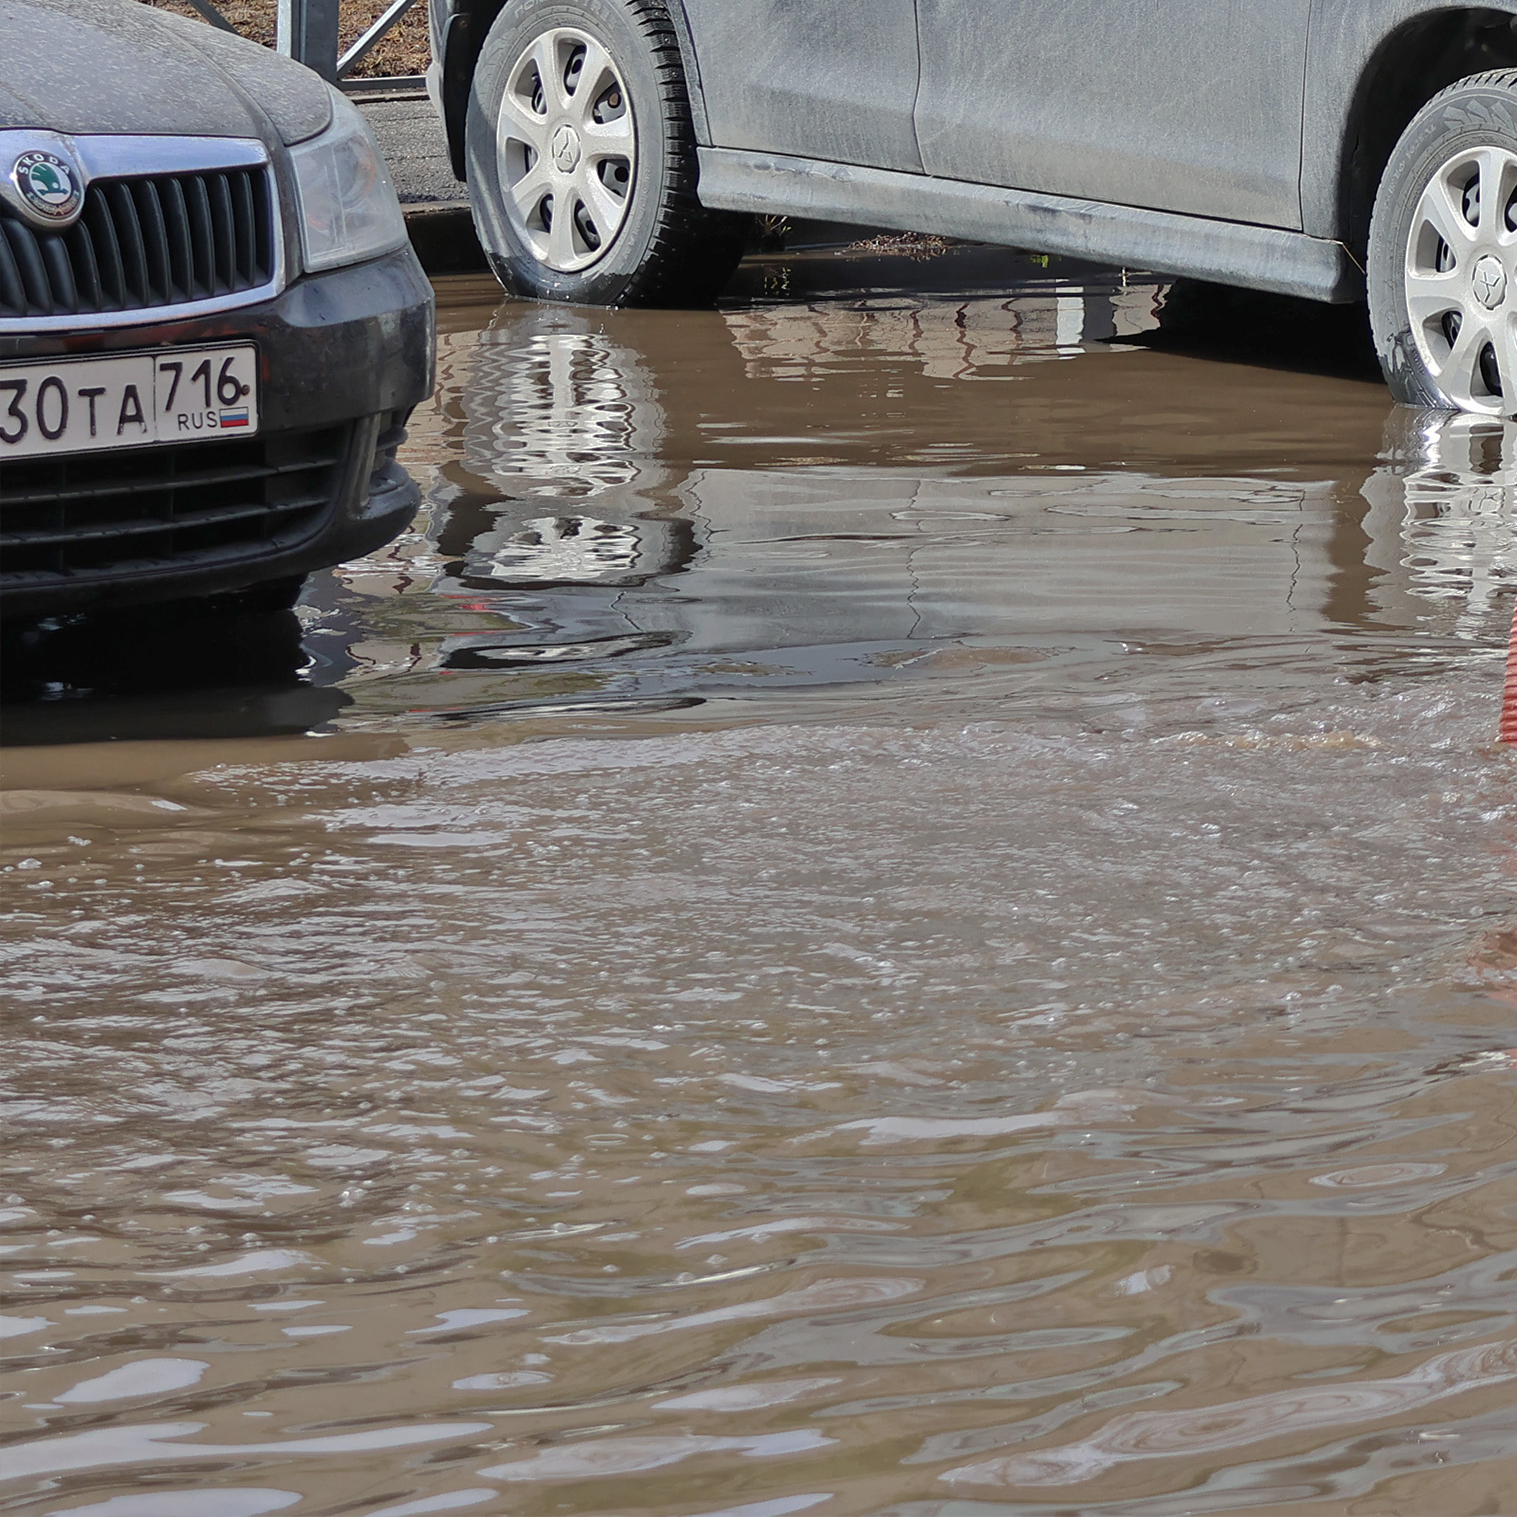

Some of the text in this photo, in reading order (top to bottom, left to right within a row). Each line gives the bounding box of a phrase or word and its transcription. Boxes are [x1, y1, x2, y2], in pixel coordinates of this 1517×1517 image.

[0, 357, 241, 444] 30ТА 716
[177, 410, 218, 432] RUS
